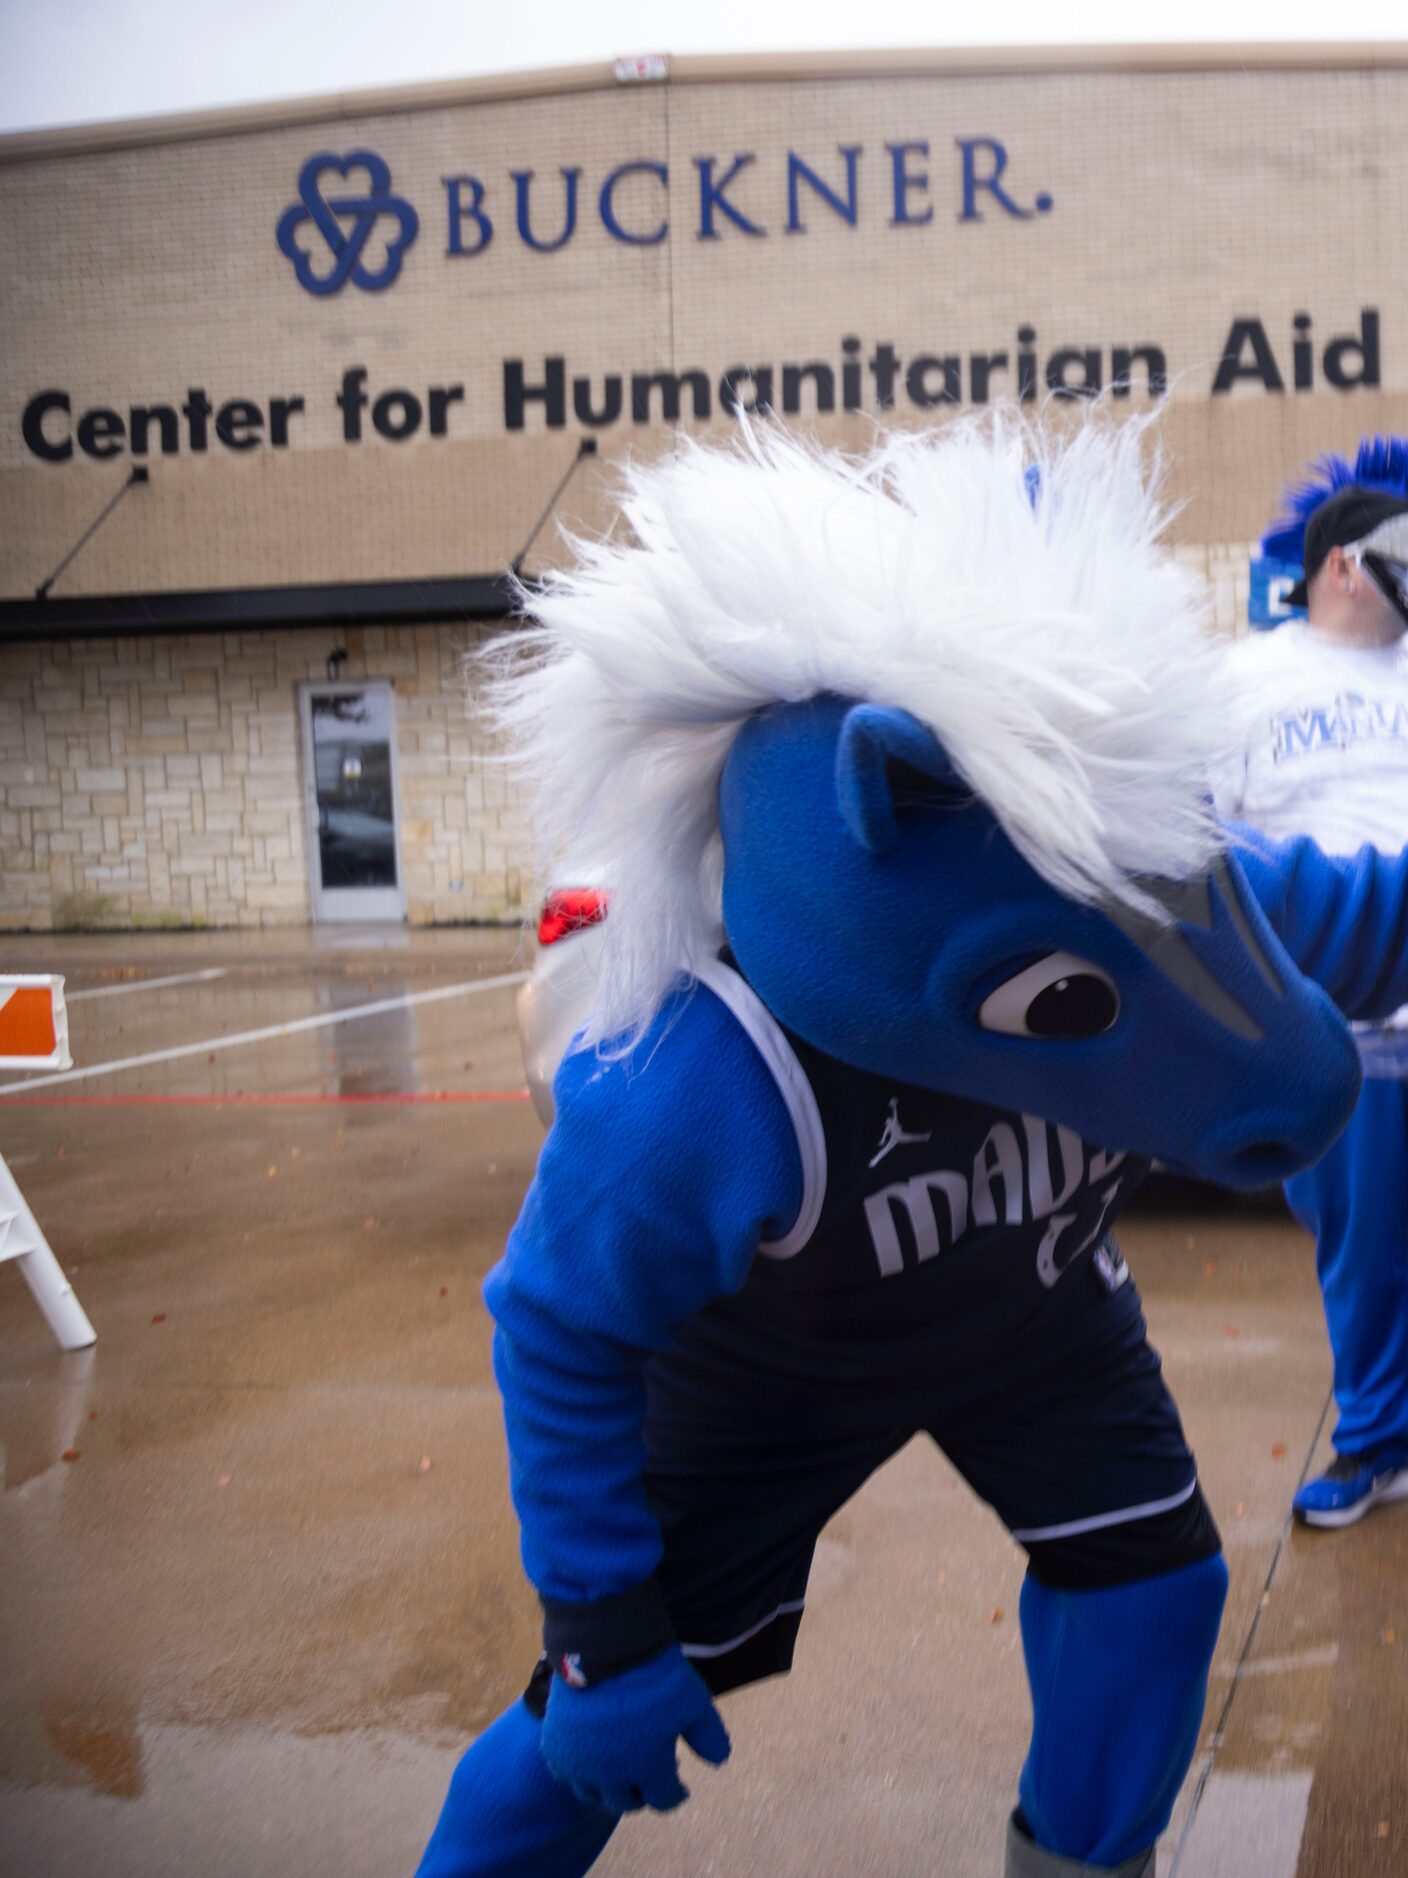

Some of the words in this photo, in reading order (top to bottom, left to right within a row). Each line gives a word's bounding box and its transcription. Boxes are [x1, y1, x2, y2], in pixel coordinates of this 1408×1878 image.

[22, 389, 305, 463] Center
[336, 366, 465, 443] for
[503, 325, 1168, 432] Humanitarian
[1211, 308, 1382, 395] Aid
